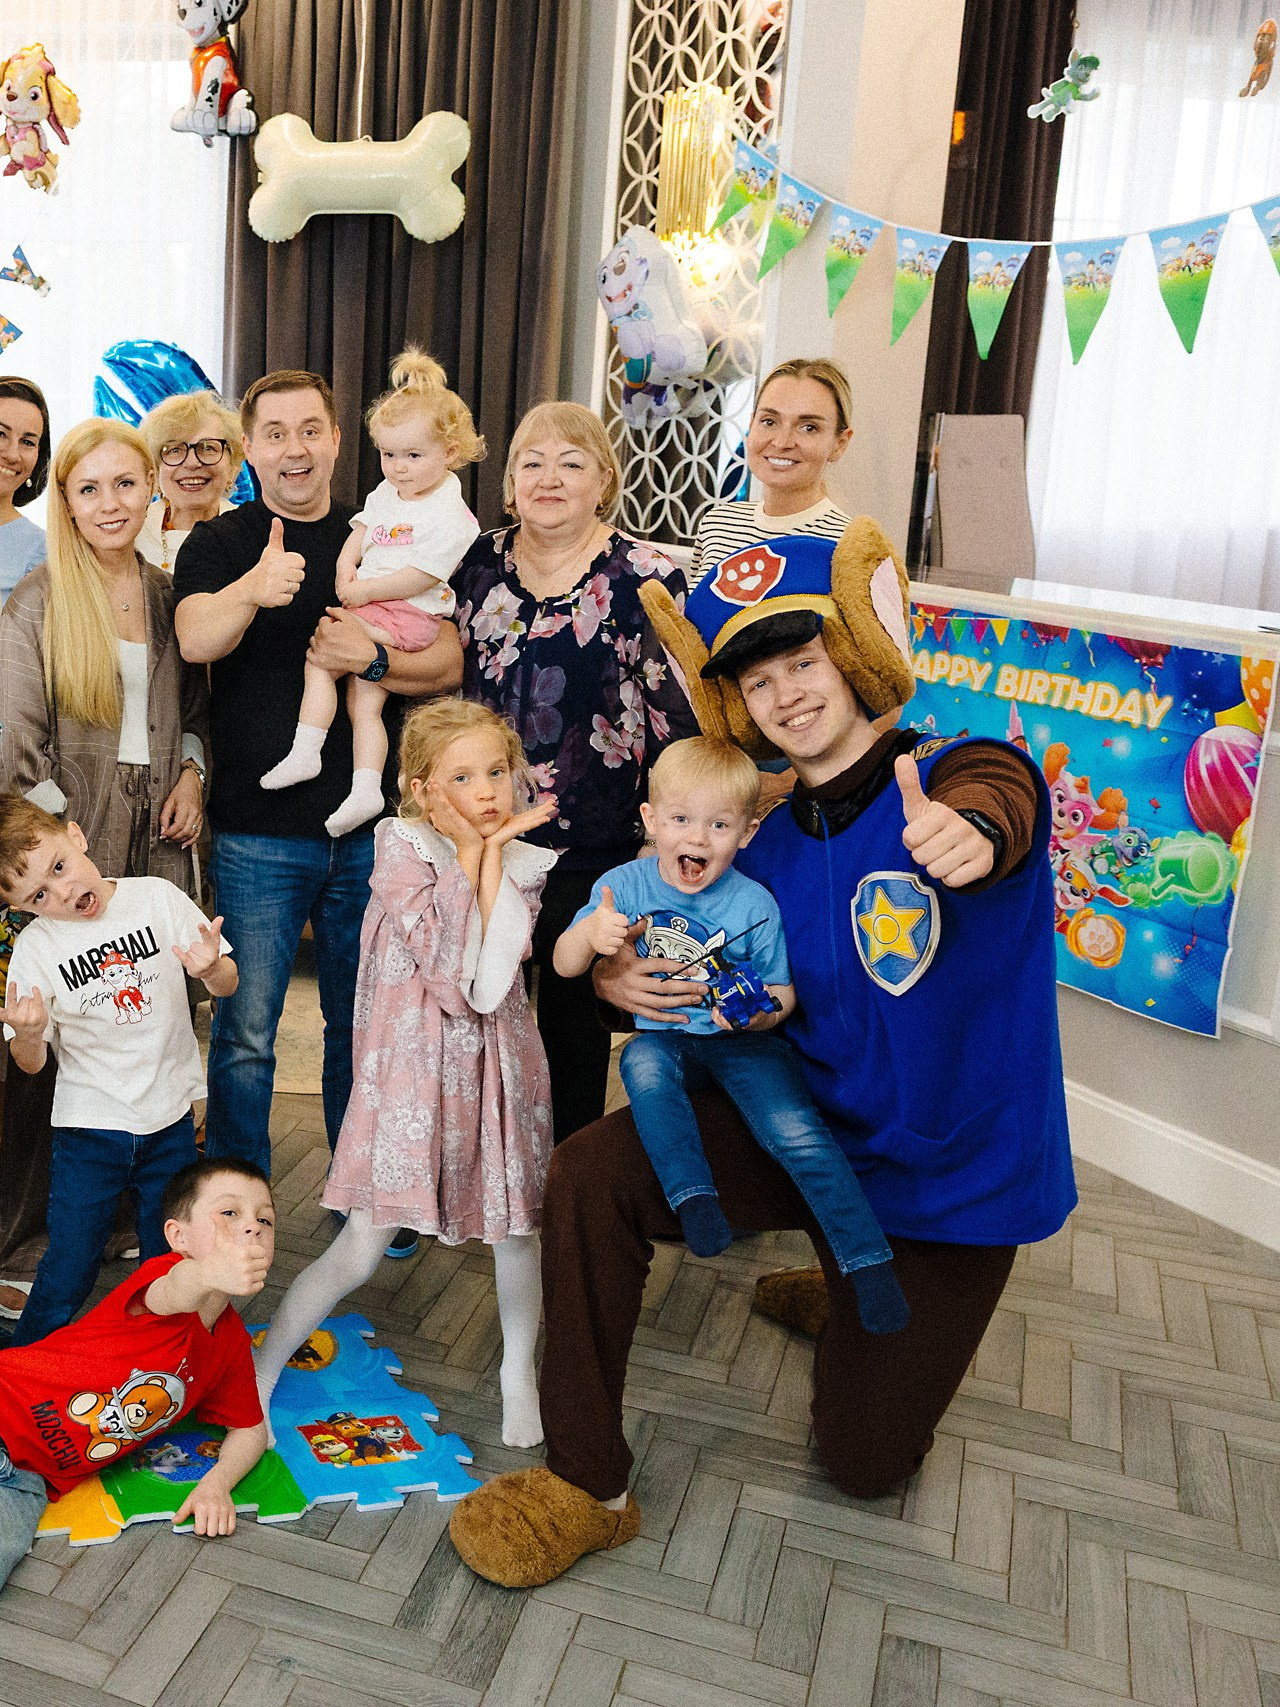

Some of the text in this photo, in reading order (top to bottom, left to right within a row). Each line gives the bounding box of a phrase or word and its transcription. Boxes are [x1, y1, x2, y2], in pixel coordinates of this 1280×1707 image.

[911, 649, 1173, 728] APPY BIRTHDAY
[58, 926, 160, 992] MARSHALL
[30, 1399, 82, 1471] MOSCHI
